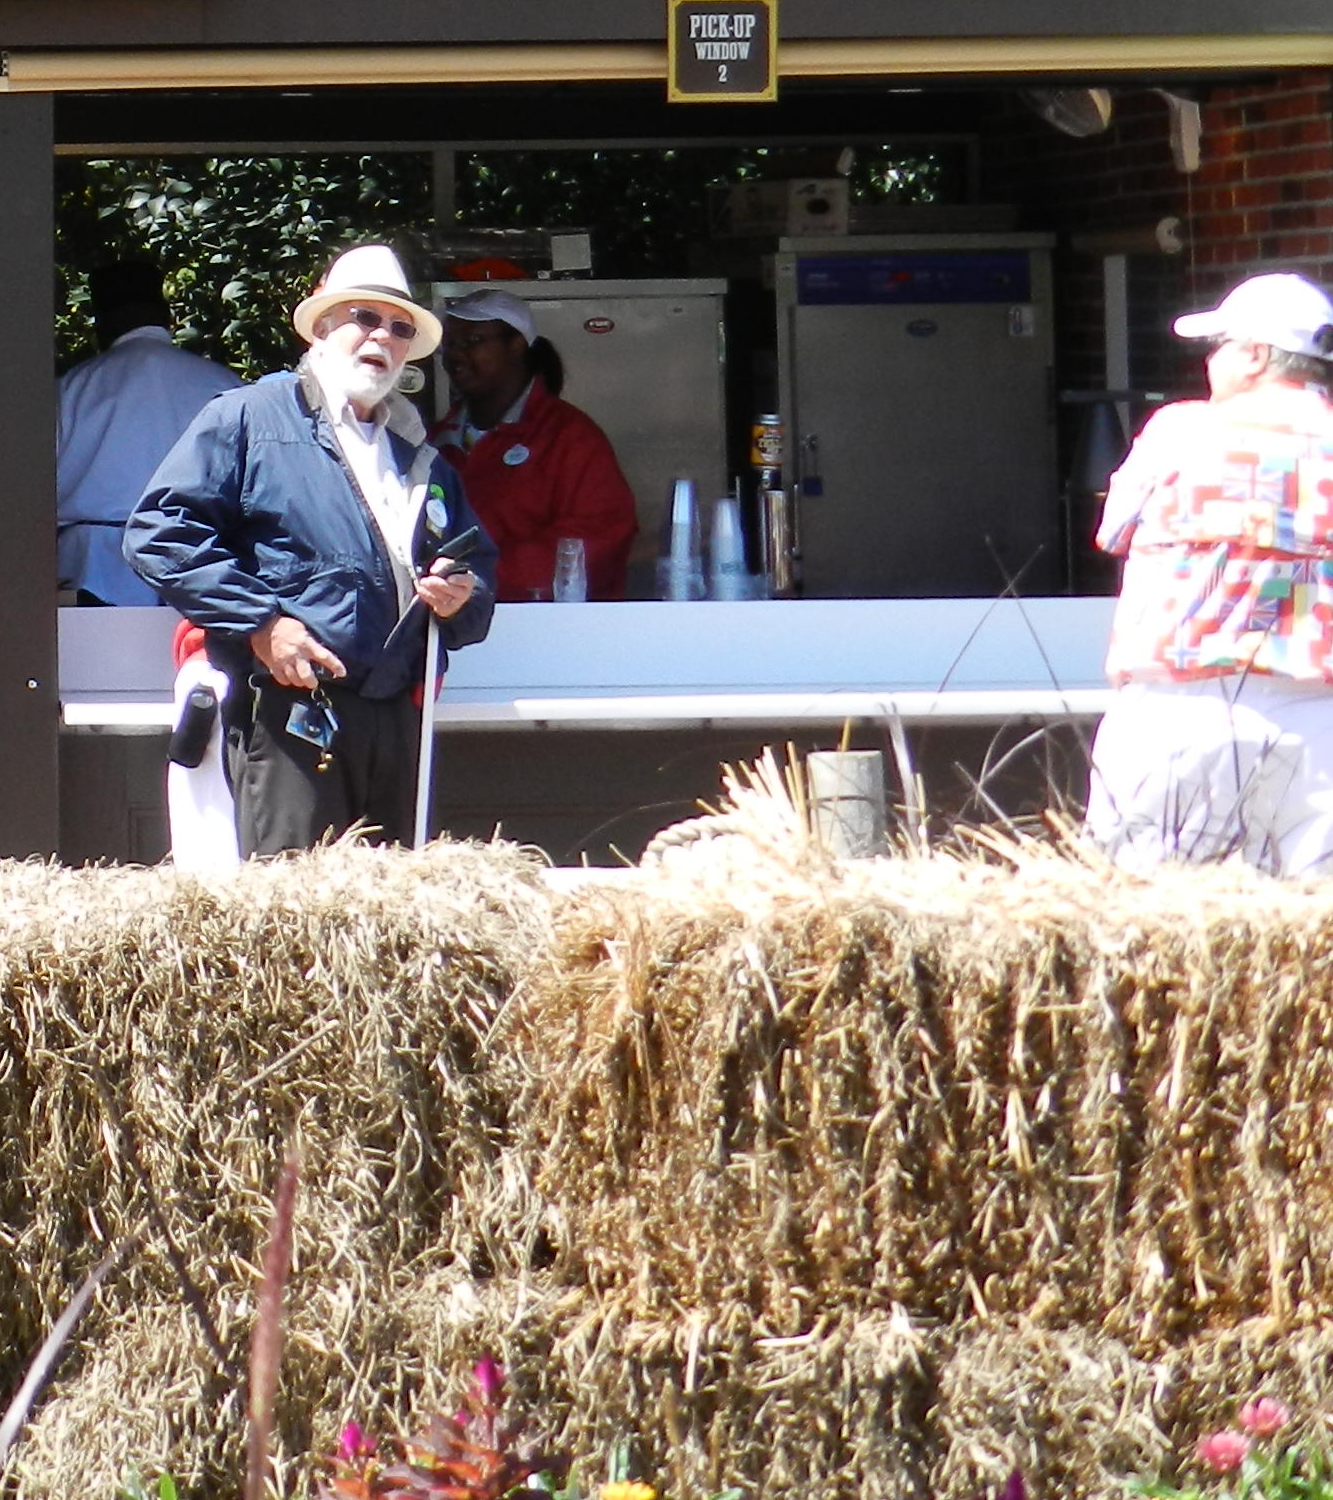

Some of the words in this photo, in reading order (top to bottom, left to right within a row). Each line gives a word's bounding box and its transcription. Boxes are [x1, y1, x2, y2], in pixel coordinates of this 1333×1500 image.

[689, 14, 756, 39] PICK-UP
[695, 41, 751, 61] WINDOW
[717, 64, 728, 83] 2
